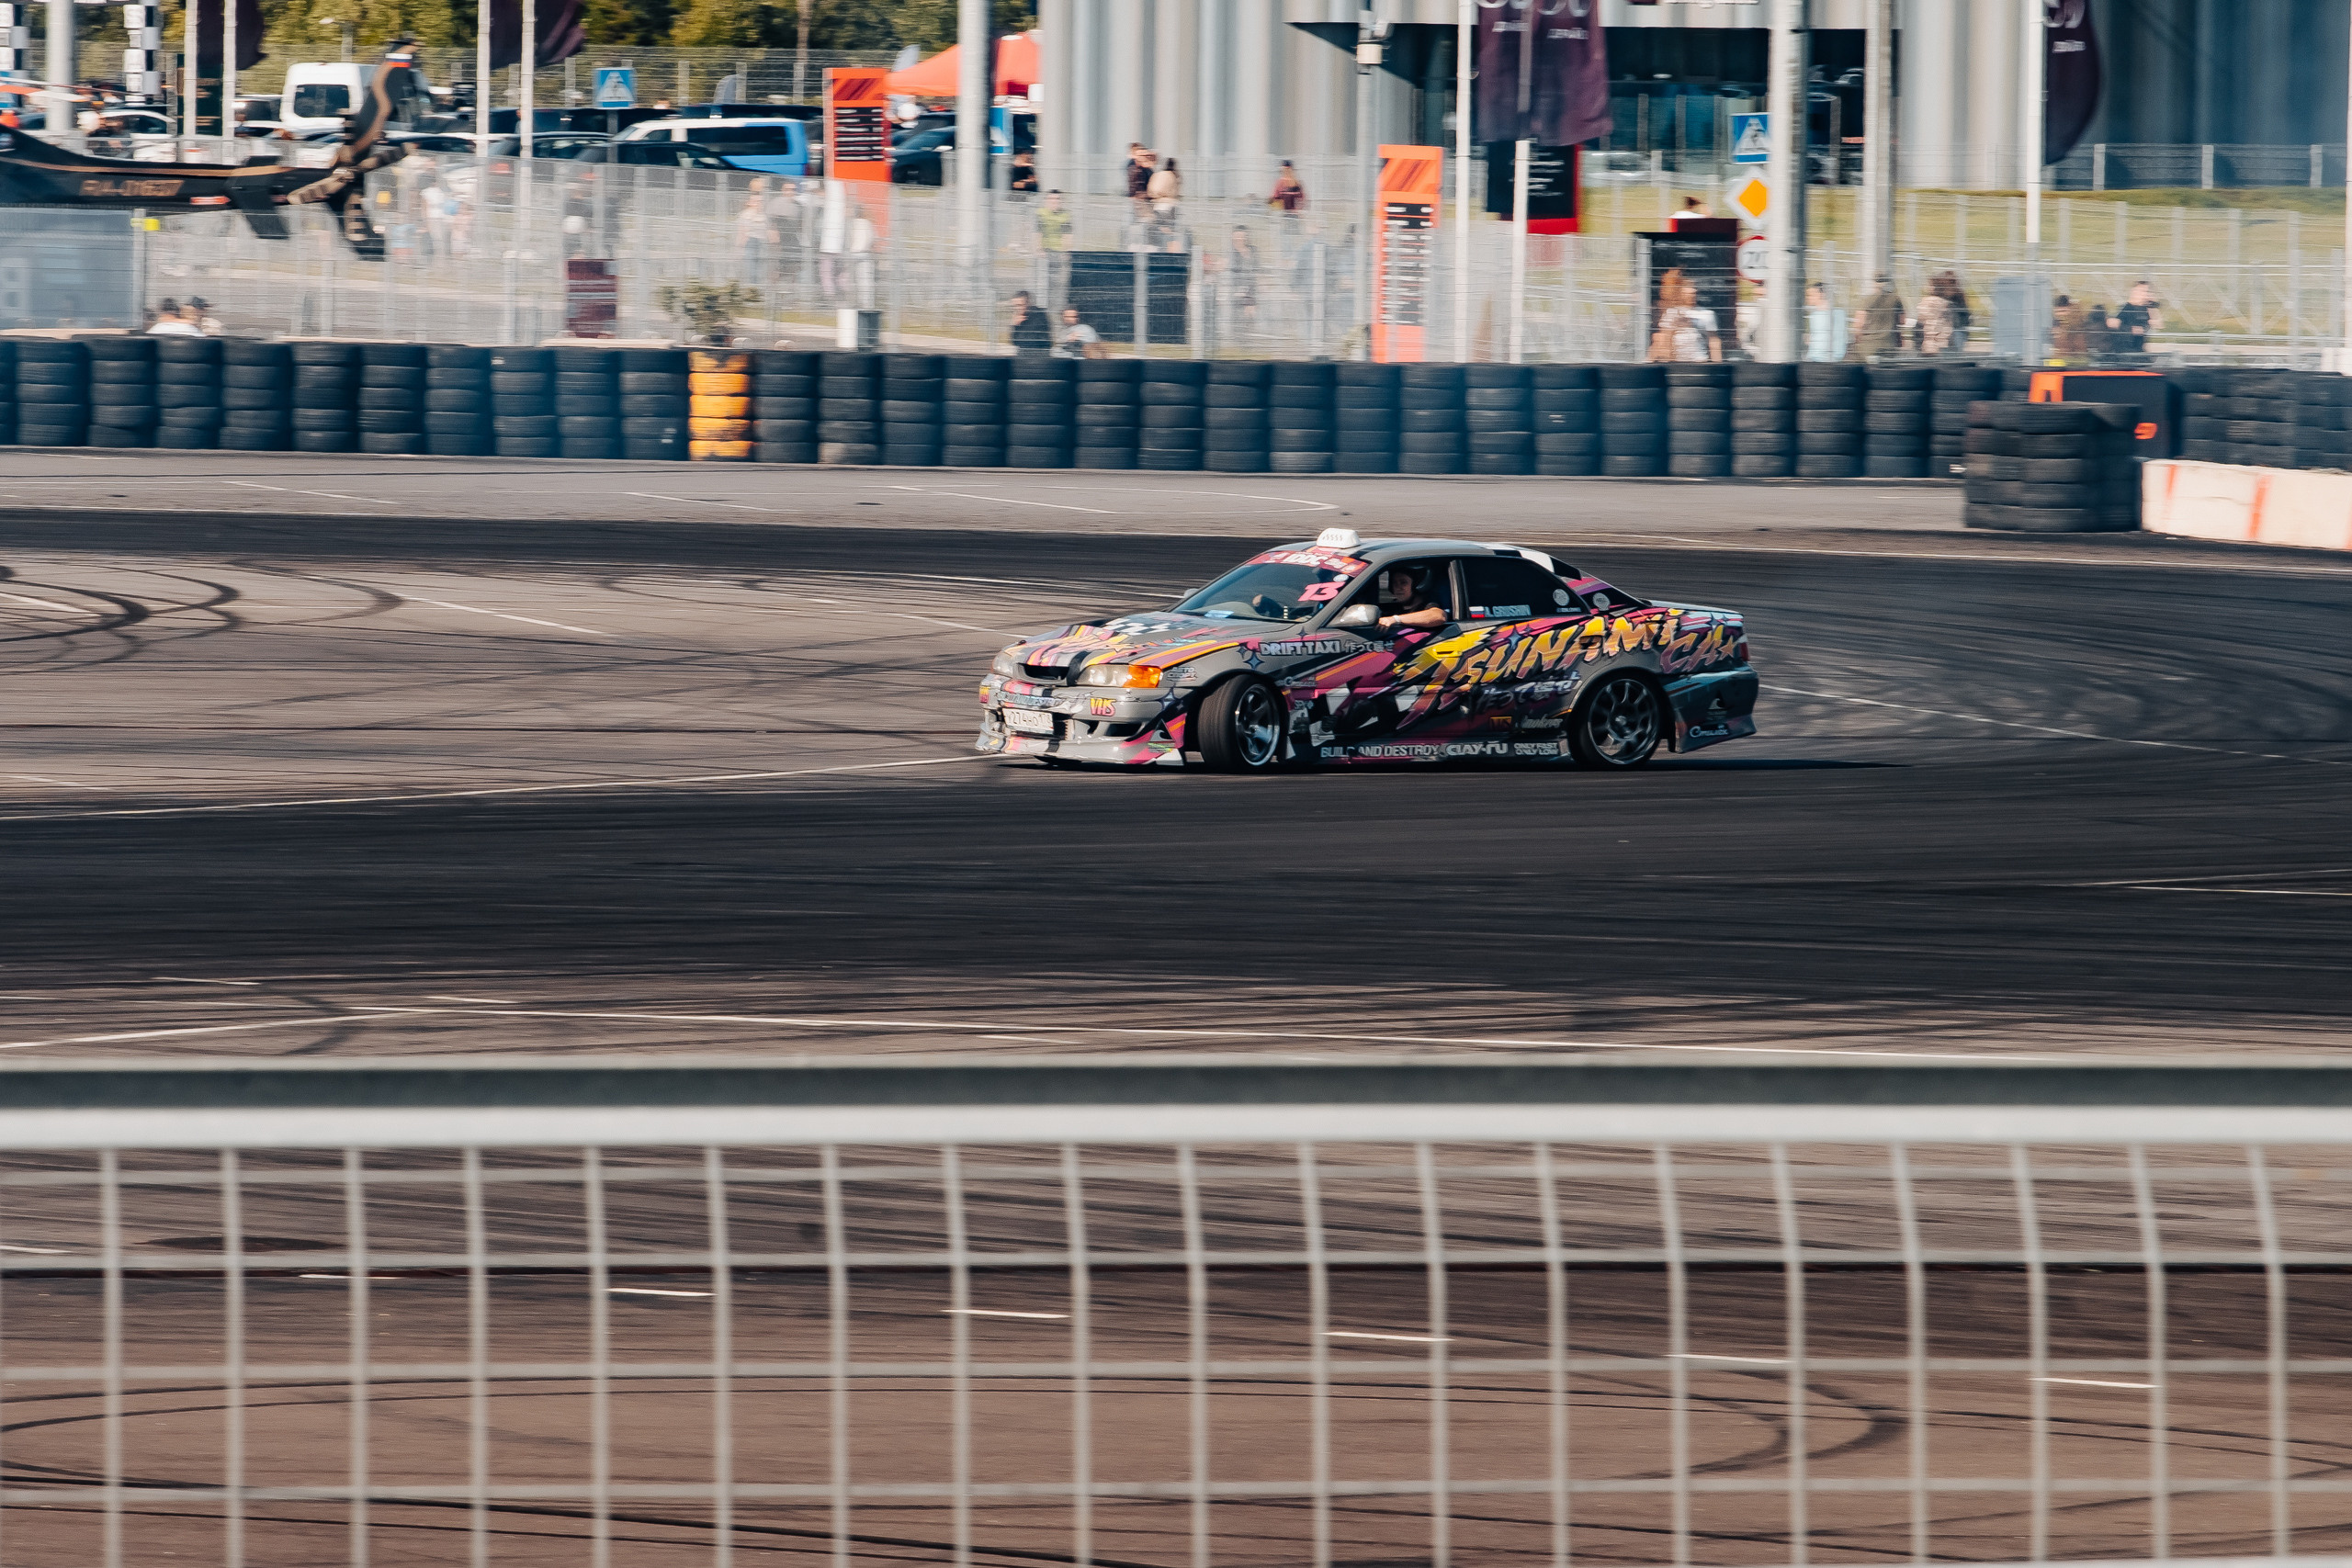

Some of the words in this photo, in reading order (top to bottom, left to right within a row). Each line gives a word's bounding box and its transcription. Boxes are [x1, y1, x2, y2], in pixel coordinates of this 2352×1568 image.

[1298, 581, 1346, 602] 13
[1260, 641, 1303, 655] DRIFT
[1305, 640, 1340, 654] TAXI
[1389, 608, 1683, 716] TSUNAMI
[1091, 697, 1116, 716] VHS
[1358, 745, 1383, 757] AND
